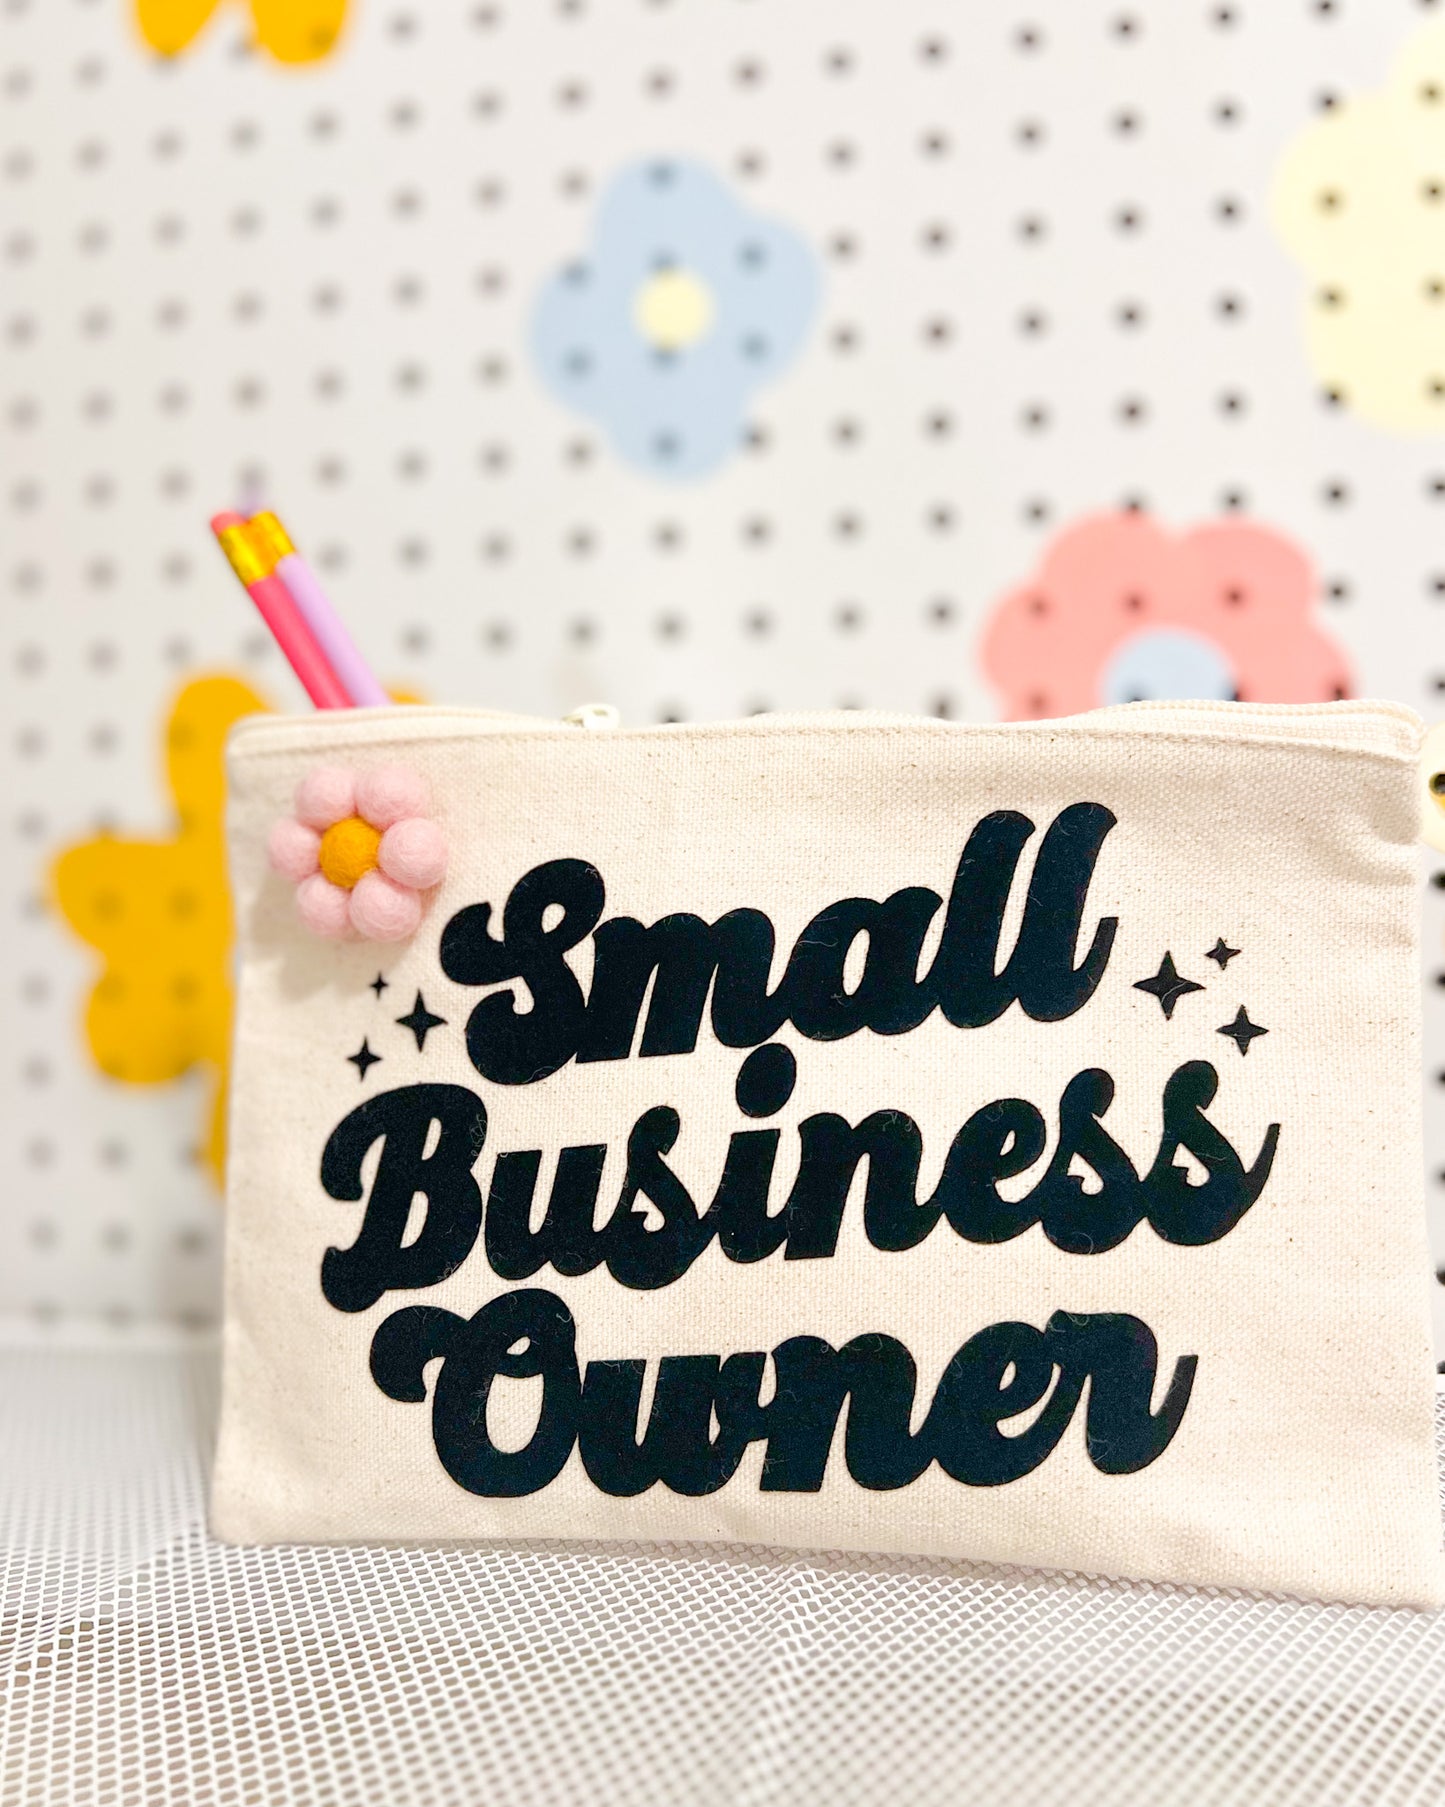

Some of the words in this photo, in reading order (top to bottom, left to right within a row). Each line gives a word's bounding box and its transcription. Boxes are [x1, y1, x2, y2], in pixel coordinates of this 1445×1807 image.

[440, 801, 1118, 1086] Small
[320, 1043, 1281, 1314] Business
[369, 1287, 1199, 1499] Owner
